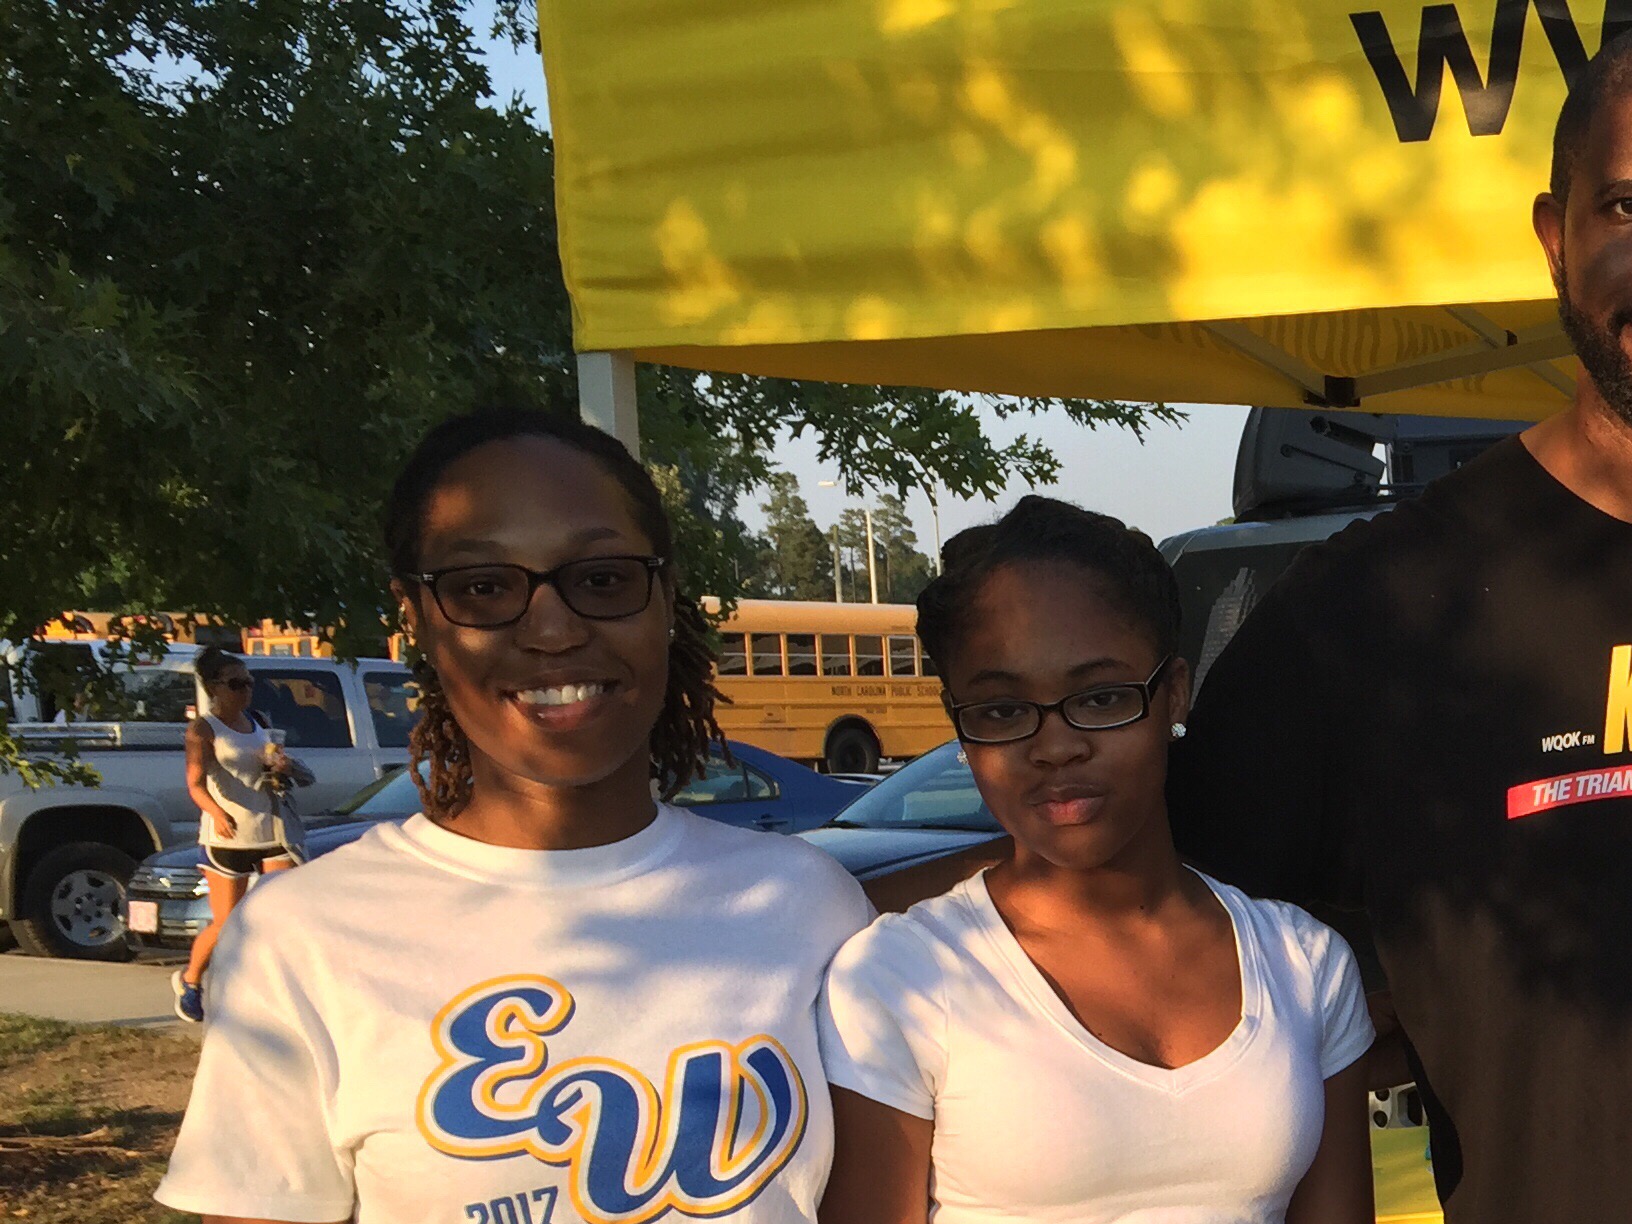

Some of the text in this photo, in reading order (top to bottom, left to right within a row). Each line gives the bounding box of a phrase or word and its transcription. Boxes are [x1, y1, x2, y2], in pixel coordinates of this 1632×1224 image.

[831, 686, 853, 696] NORTH
[857, 686, 886, 696] CAROLINA
[891, 686, 912, 696] PUBLIC
[1541, 731, 1595, 752] WQOK FM
[1532, 781, 1570, 806] THE
